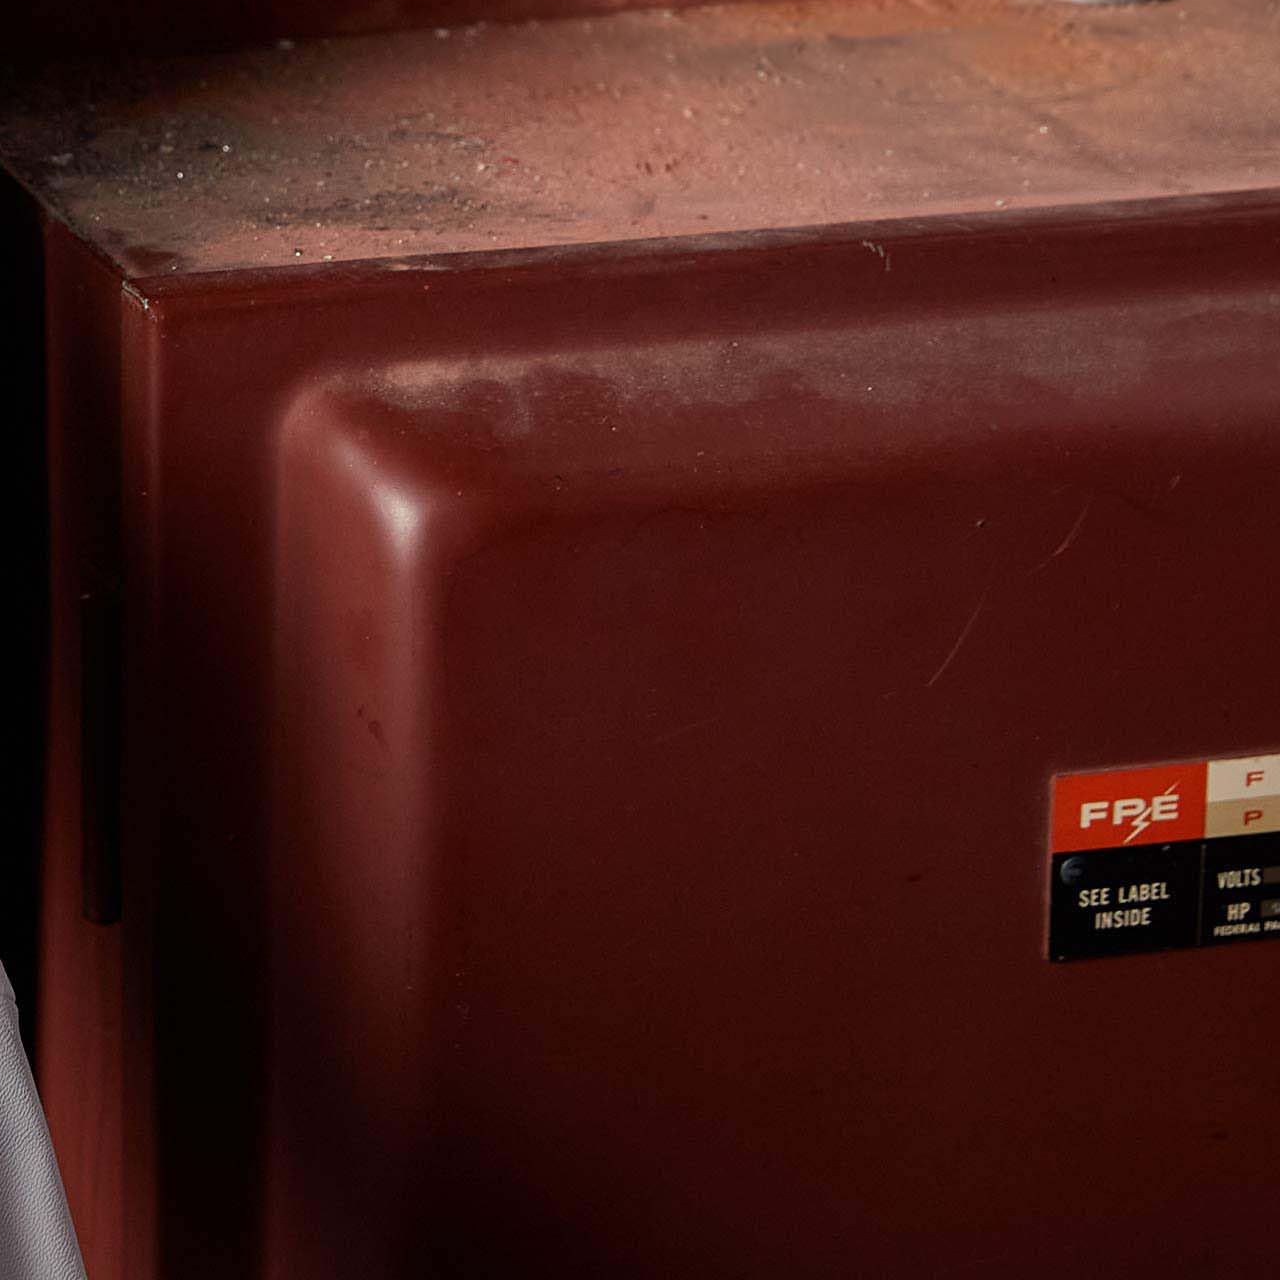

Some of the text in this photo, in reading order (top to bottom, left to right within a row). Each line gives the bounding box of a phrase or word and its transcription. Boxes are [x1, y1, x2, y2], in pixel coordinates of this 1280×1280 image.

[1245, 771, 1264, 787] F
[1243, 809, 1263, 826] P
[1218, 868, 1261, 890] VOLTS
[1078, 882, 1170, 908] SEE LABEL
[1095, 907, 1152, 930] INSIDE
[1227, 902, 1251, 922] HP
[1213, 922, 1260, 937] FEDERAL
